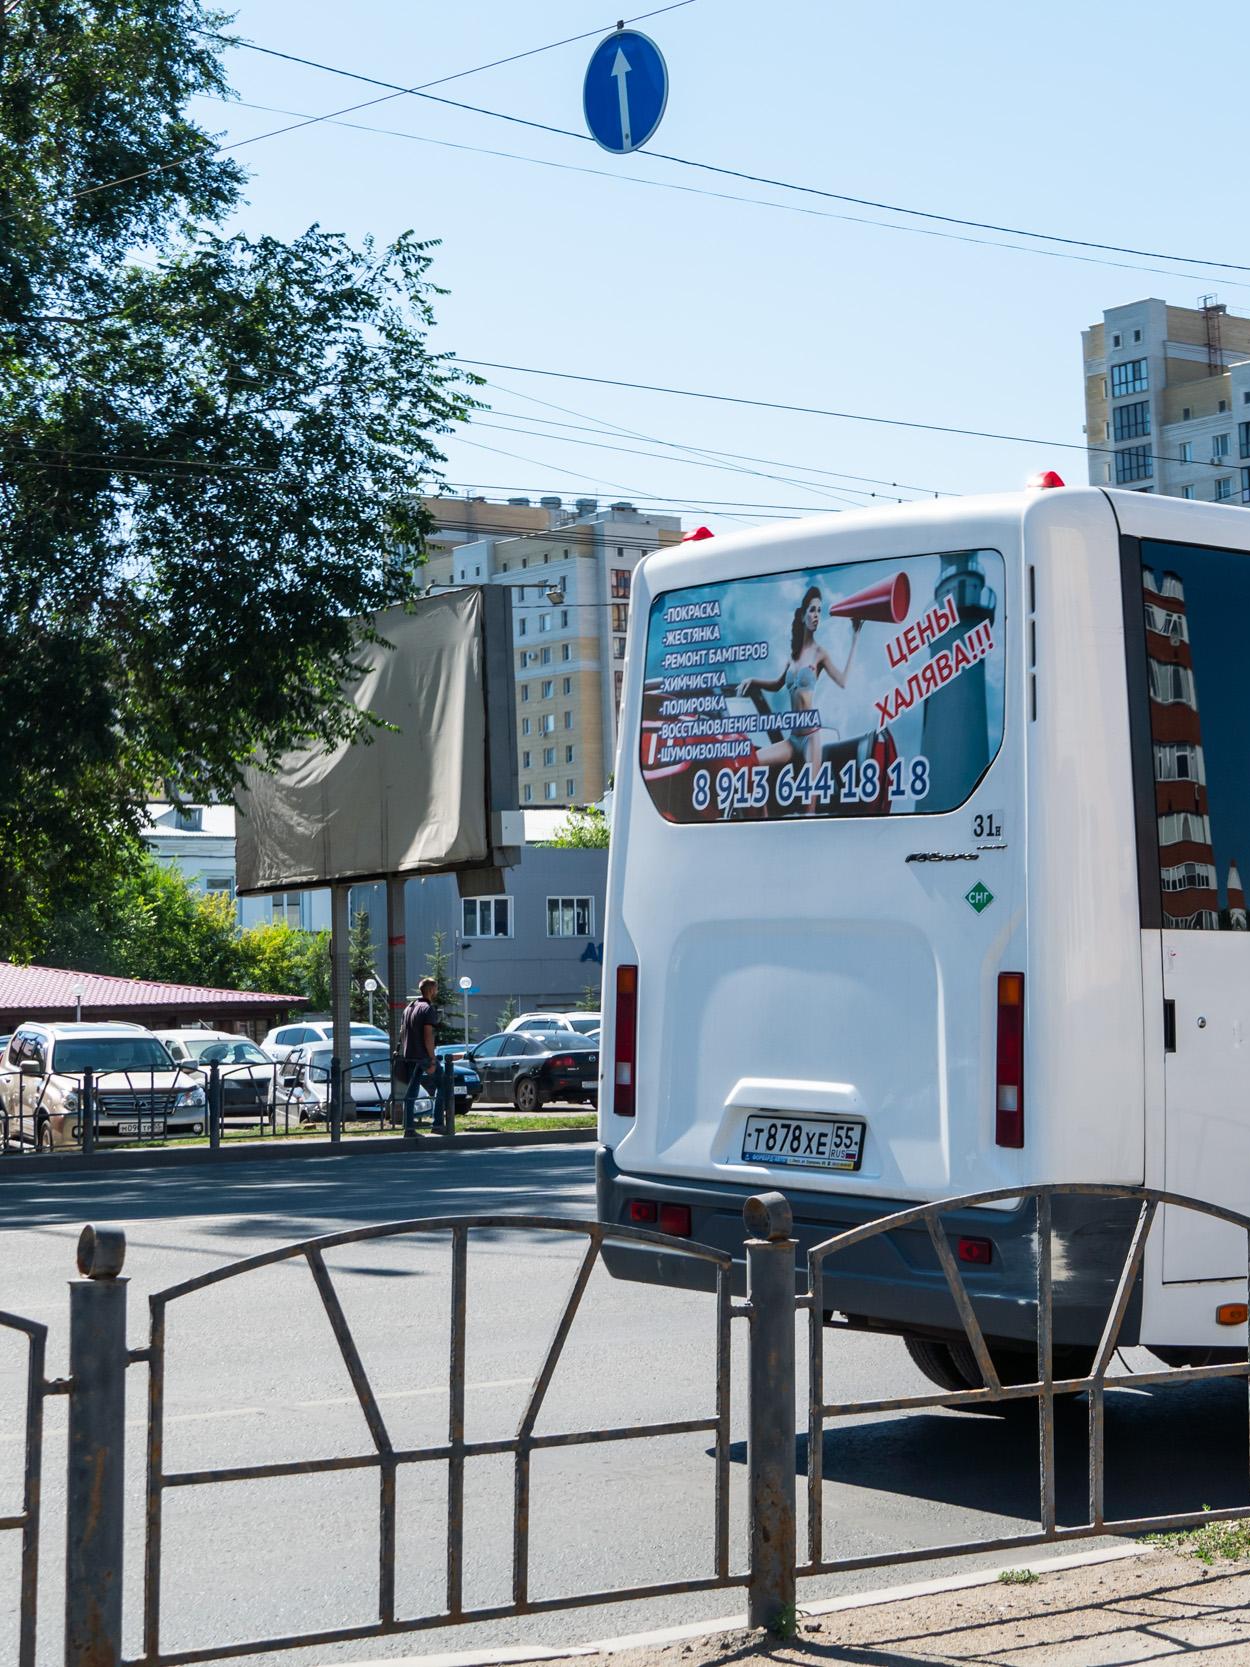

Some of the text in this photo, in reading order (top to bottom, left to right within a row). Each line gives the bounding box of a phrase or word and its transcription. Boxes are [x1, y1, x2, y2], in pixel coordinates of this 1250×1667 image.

[664, 601, 721, 622] -ПОКРАСКА
[662, 626, 721, 646] -ЖЕСТЯНКА
[885, 597, 958, 668] ЦЕНЫ
[661, 643, 768, 669] -РЕМОНТ БАМПЕРОВ
[660, 673, 727, 692] -ХИМЧИСТКА
[873, 622, 994, 728] ХАЛЯВА!!!
[659, 697, 727, 715] -ПОЛИРОВКА
[658, 711, 821, 739] -ВОССТАНОВЛЕНИЕ ПЛАСТИКА
[657, 740, 751, 763] -ШУМОИЗОЛЯЦИЯ
[692, 755, 930, 810] 8 913 644 18 18
[833, 1125, 855, 1149] 55
[830, 1149, 845, 1159] RUS
